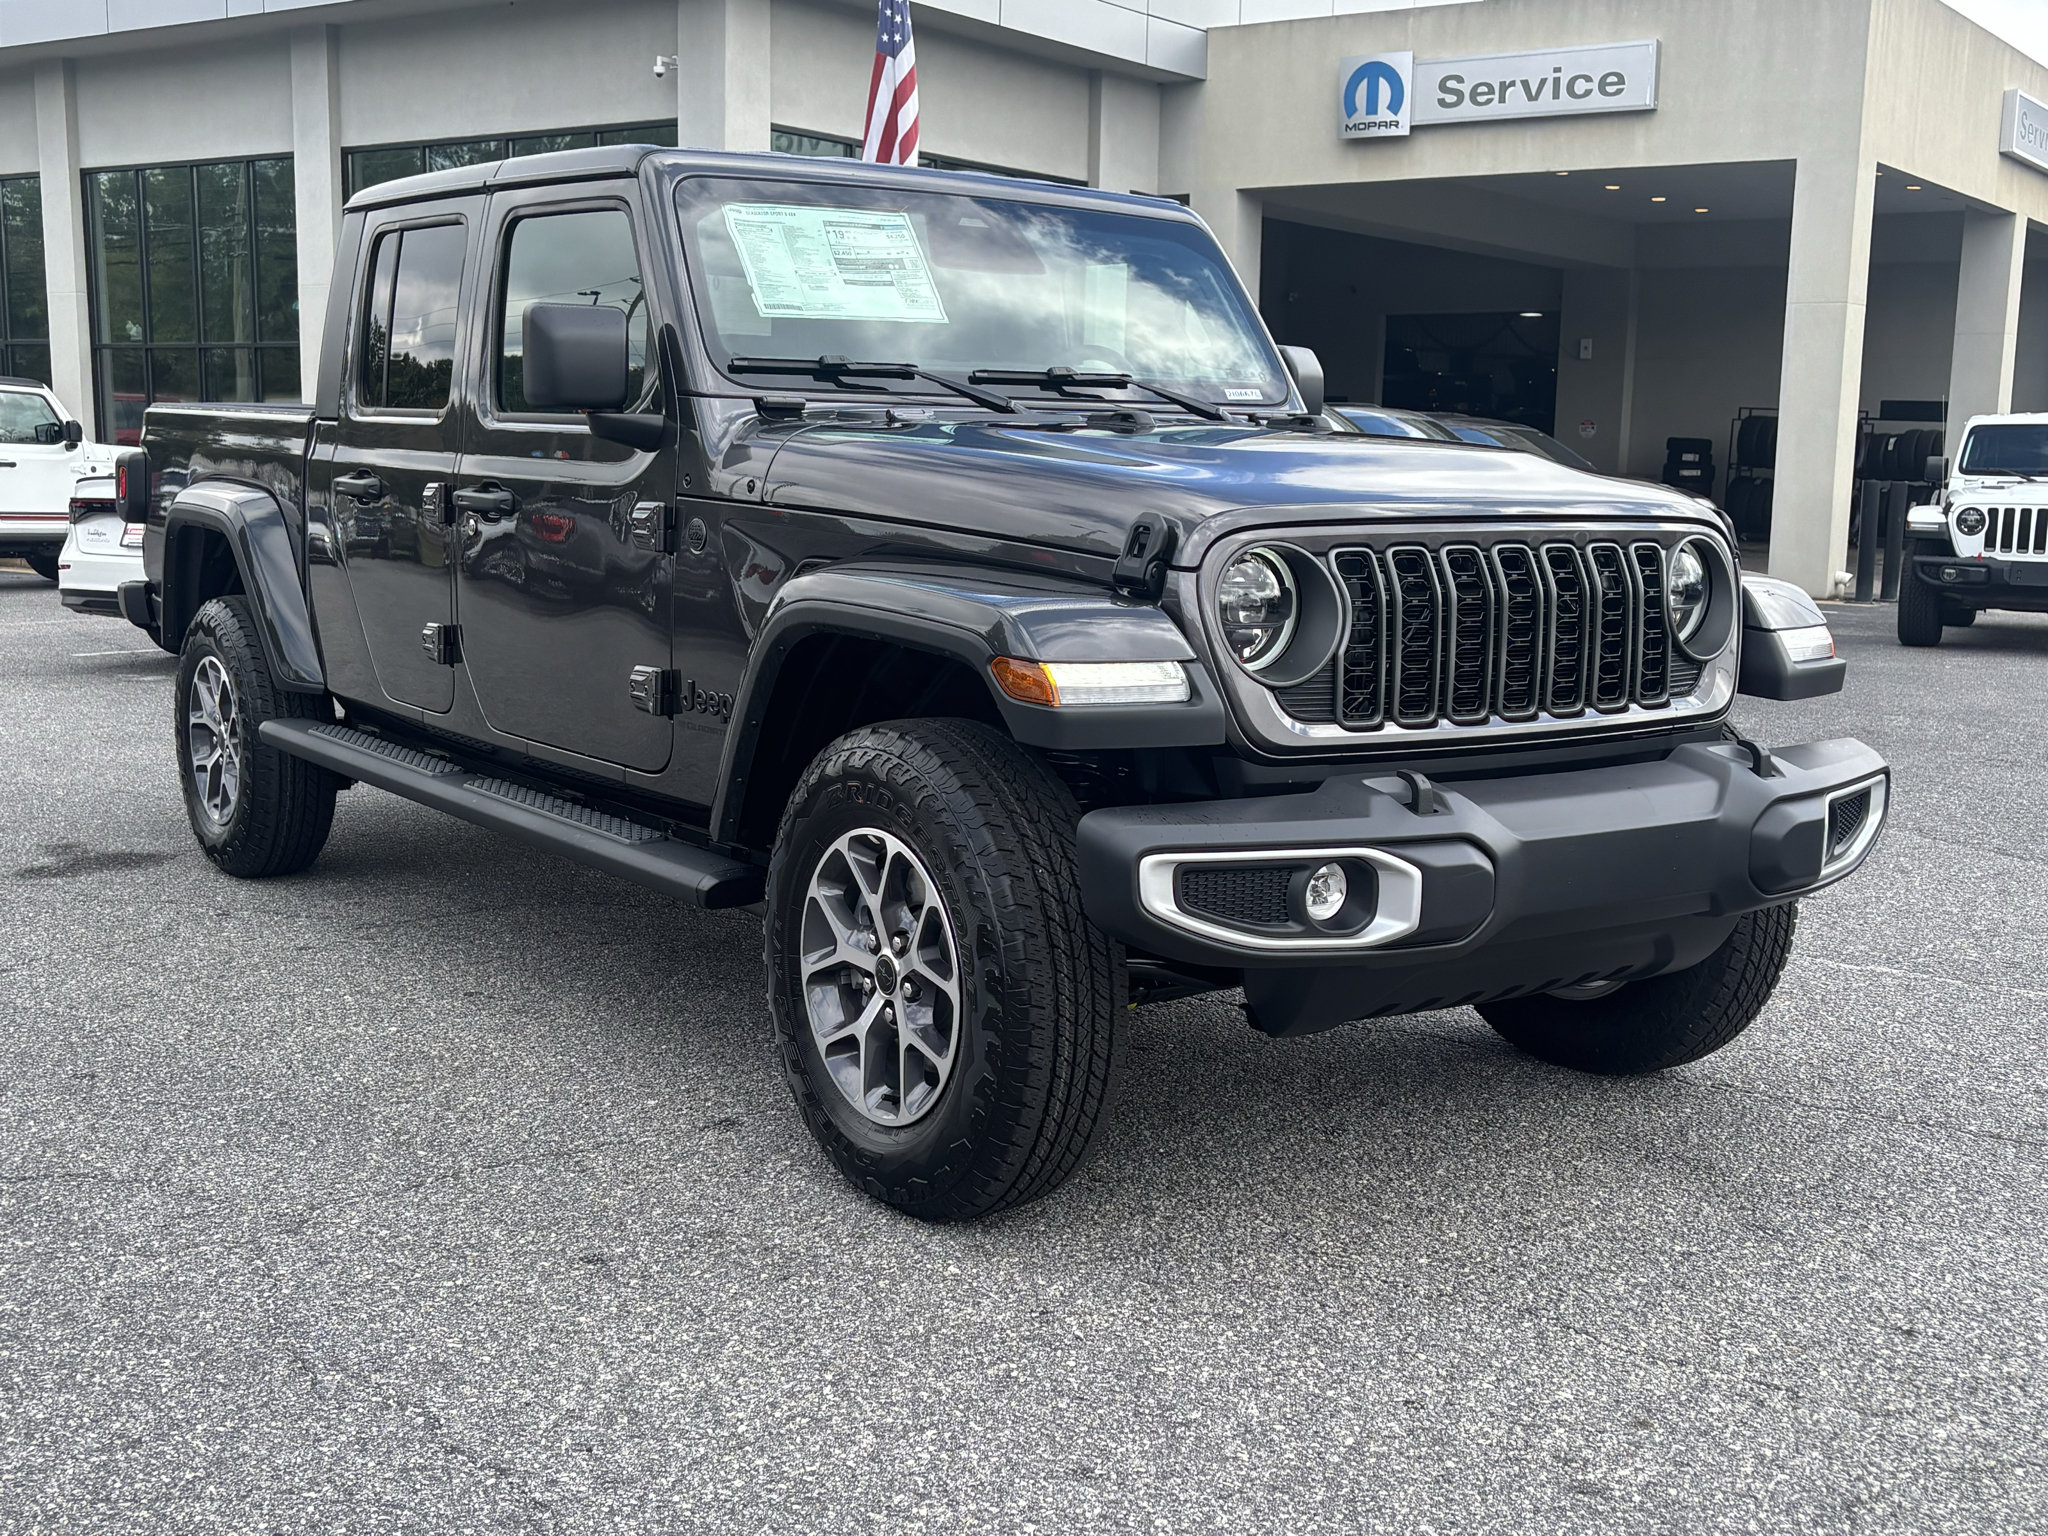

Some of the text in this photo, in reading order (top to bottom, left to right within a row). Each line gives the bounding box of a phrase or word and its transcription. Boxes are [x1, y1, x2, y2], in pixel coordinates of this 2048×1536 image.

[1437, 66, 1626, 109] Service
[1345, 120, 1400, 132] MOPAR
[832, 230, 844, 239] 19
[682, 679, 732, 724] Jeep
